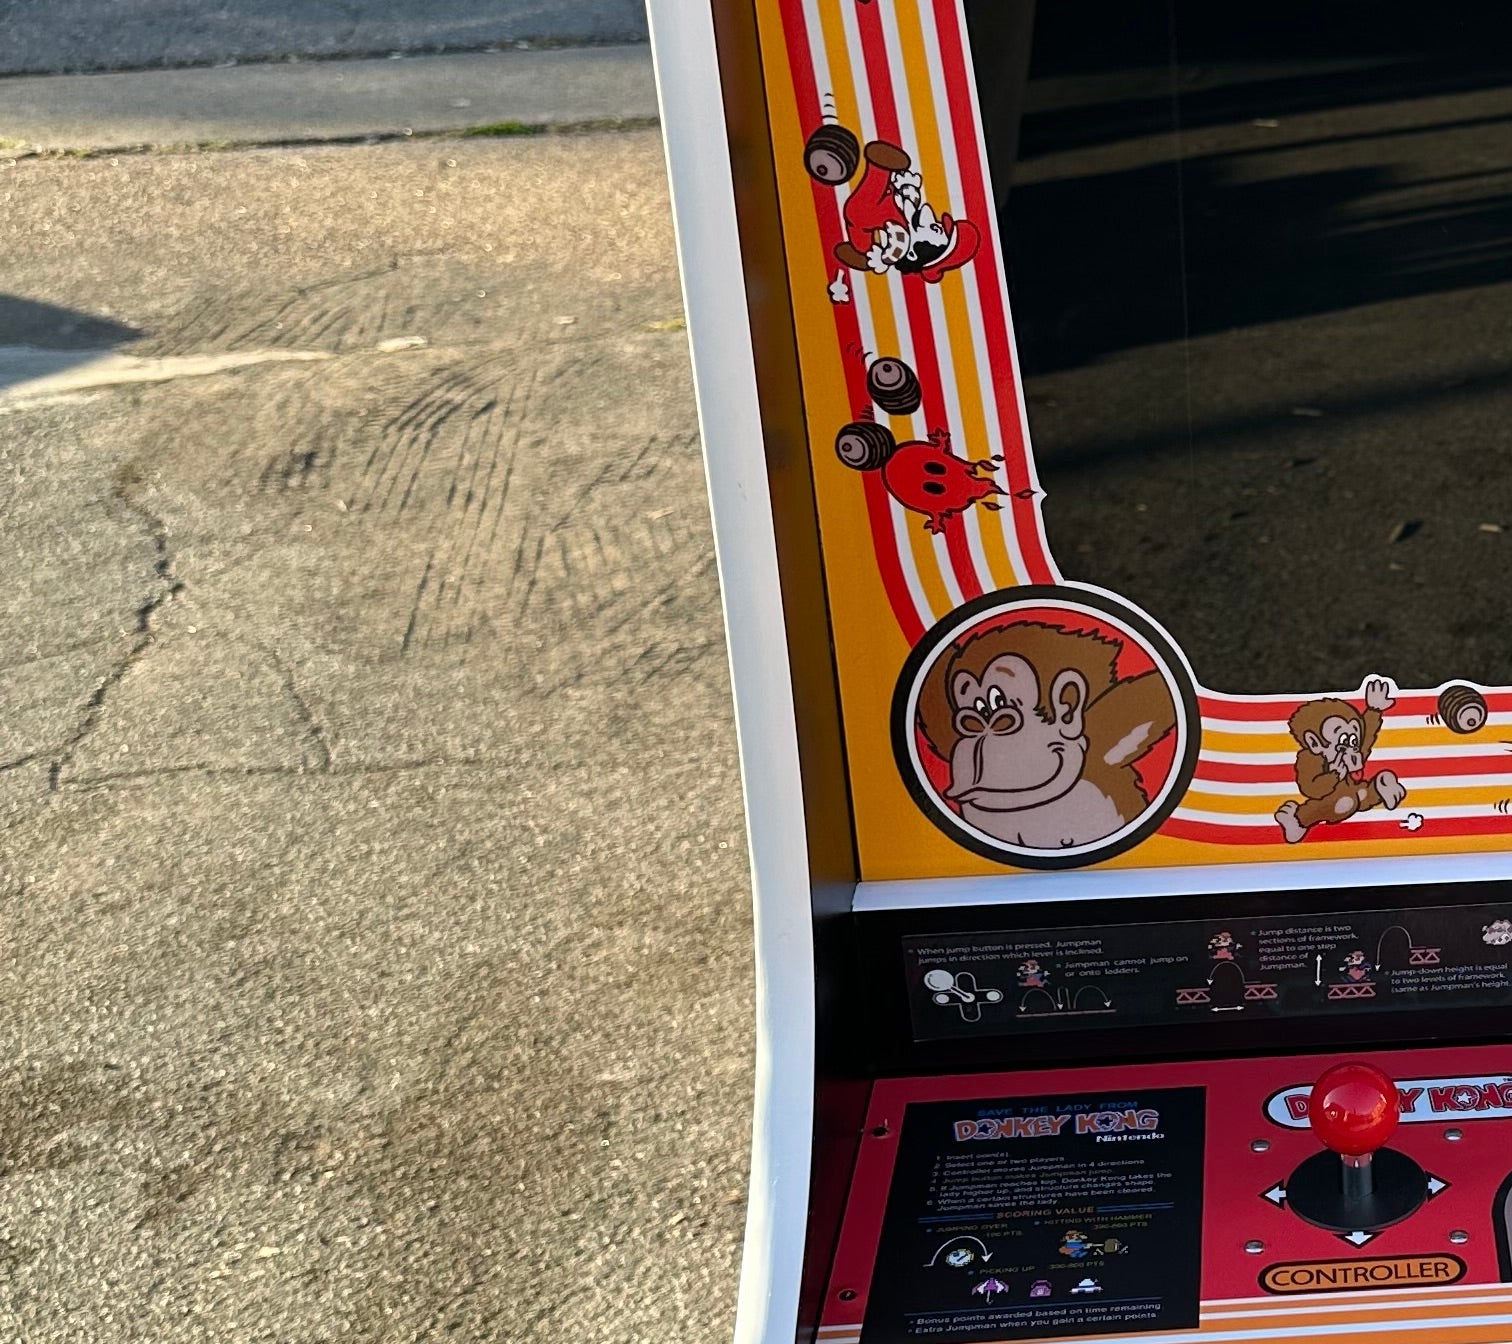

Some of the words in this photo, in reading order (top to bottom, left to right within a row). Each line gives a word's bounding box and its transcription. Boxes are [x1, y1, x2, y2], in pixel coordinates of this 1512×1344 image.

[977, 1108, 1012, 1116] SAVE
[1056, 1104, 1092, 1112] LADY
[1100, 1101, 1138, 1110] FROM
[953, 1114, 1071, 1142] DONKEY
[1076, 1109, 1160, 1134] KONG
[1096, 1133, 1165, 1143] Nintendo
[997, 1209, 1052, 1219] SCORING
[1055, 1207, 1095, 1216] VALUE
[1271, 1261, 1450, 1287] CONTROLLER
